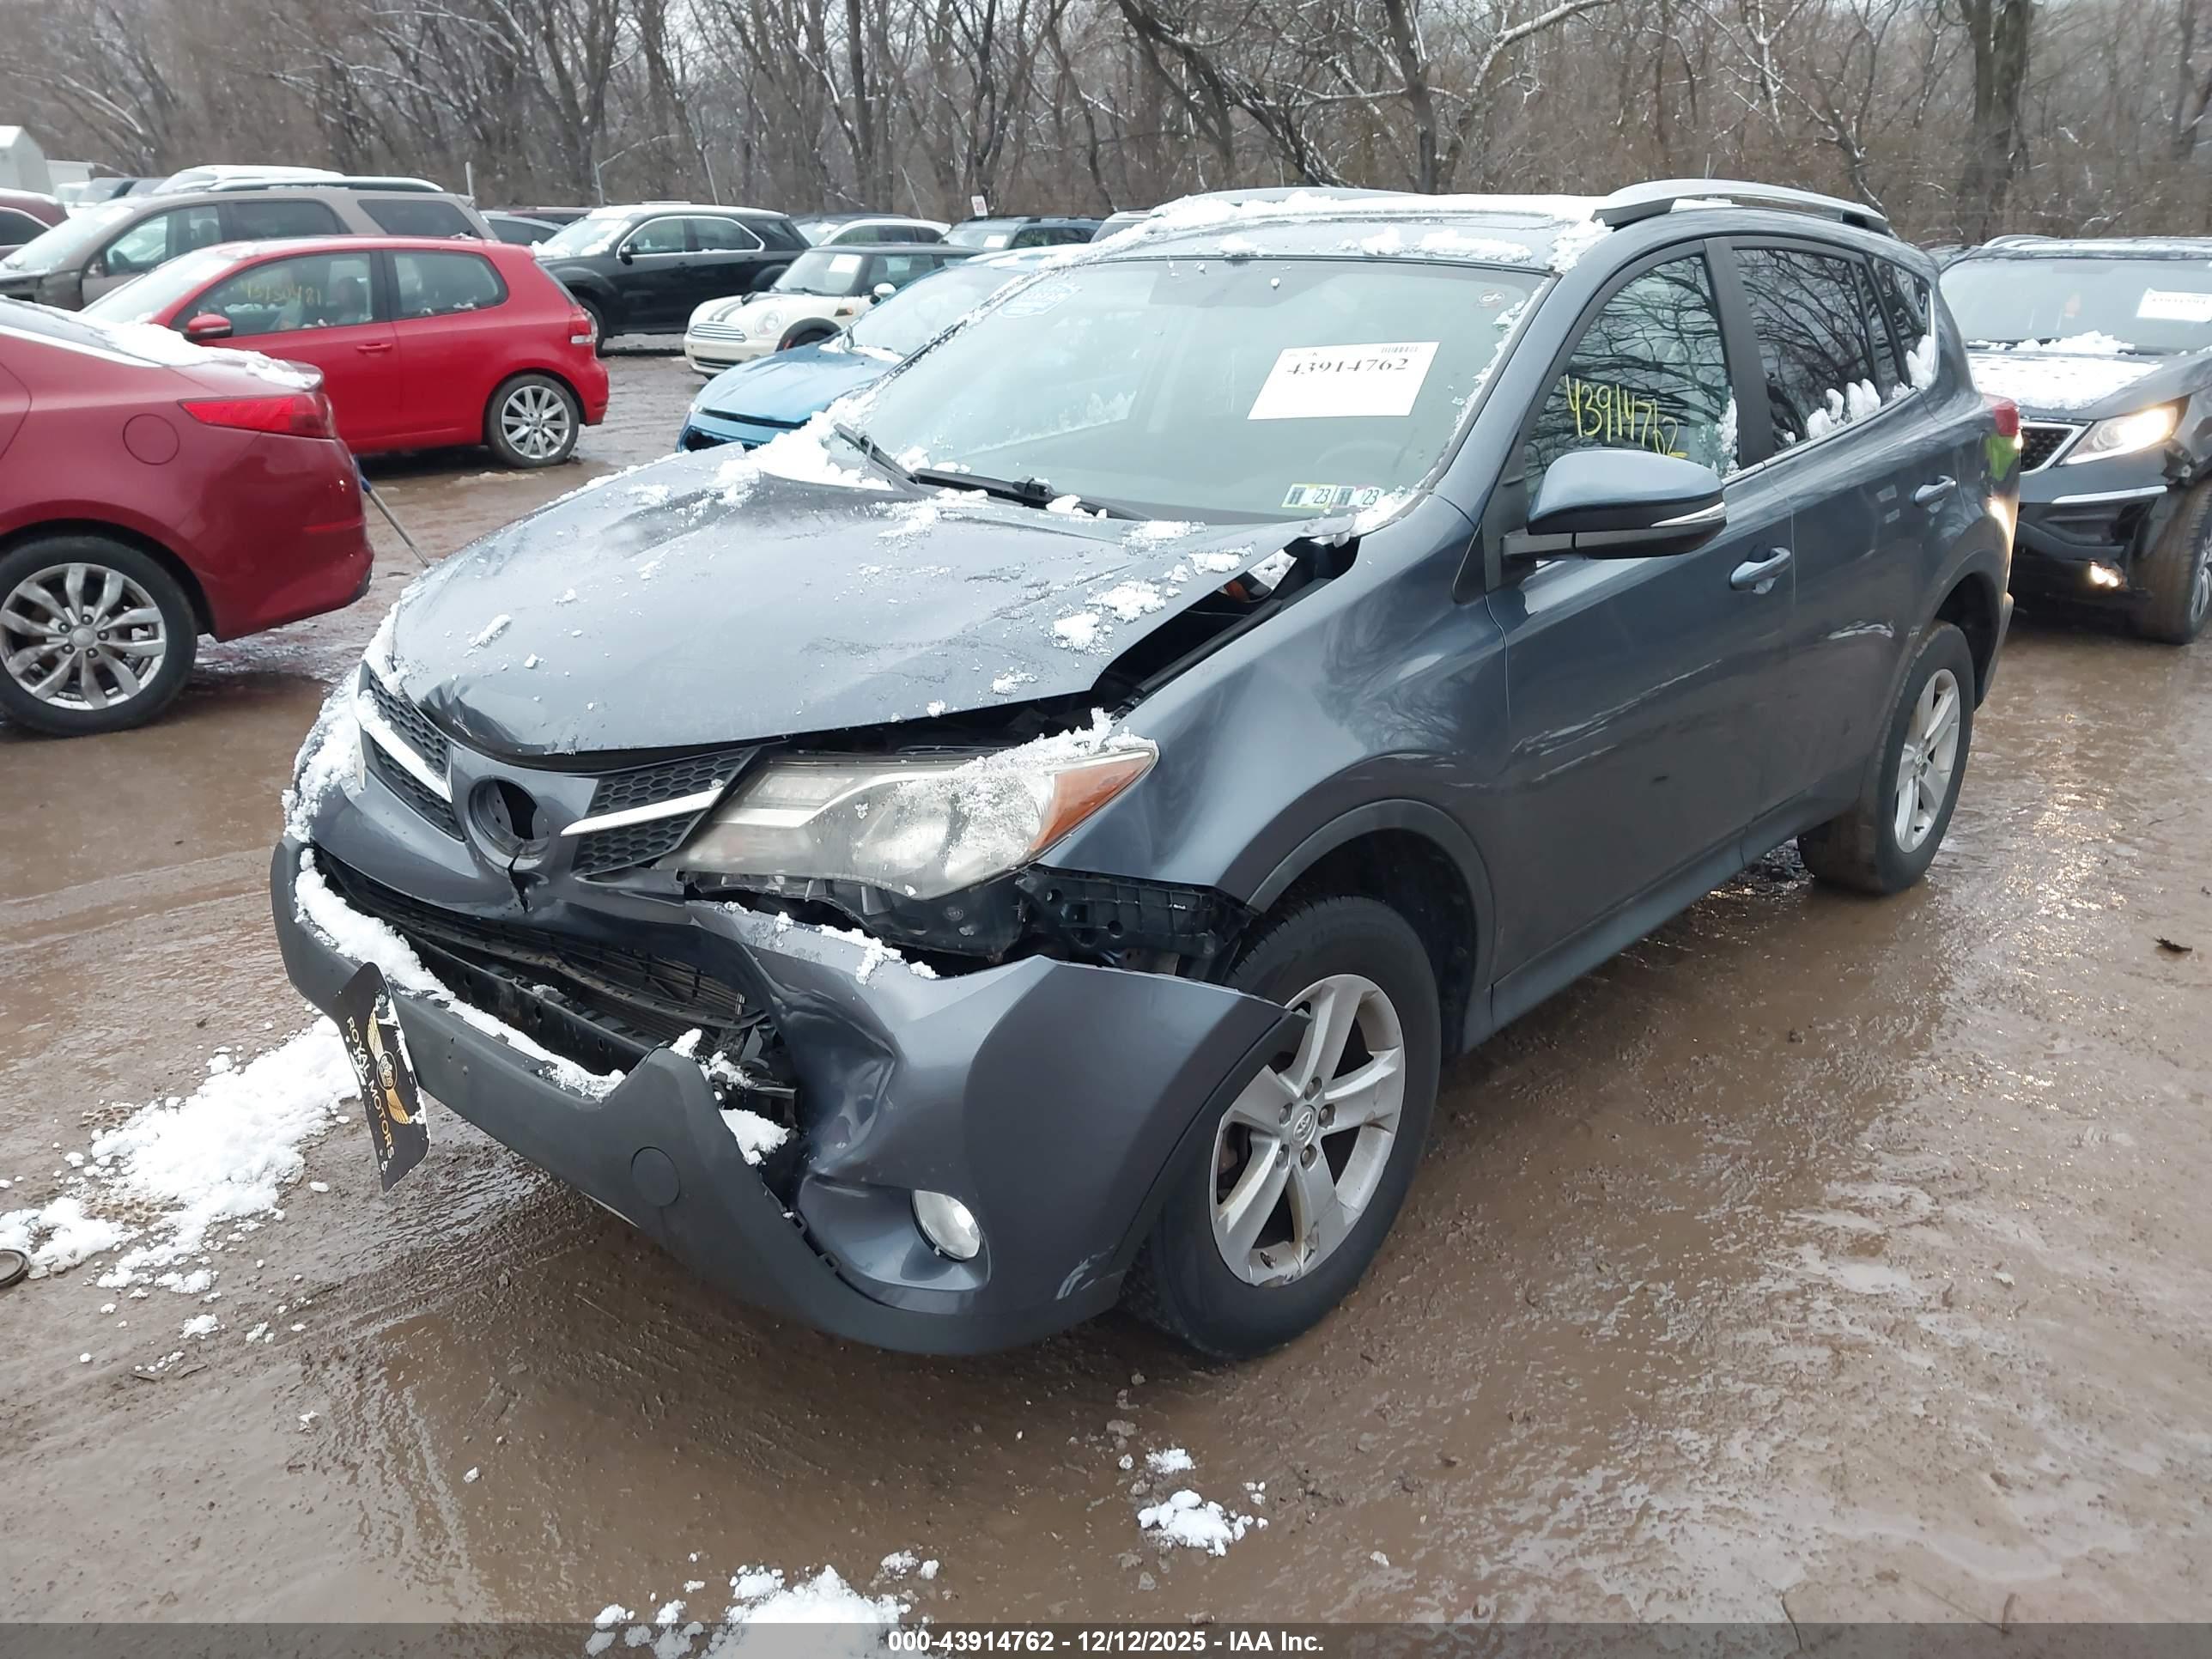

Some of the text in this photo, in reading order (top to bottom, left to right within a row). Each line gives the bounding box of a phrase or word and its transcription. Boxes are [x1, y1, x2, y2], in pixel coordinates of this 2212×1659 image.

[1286, 357, 1409, 375] 43914762
[1565, 374, 1689, 458] 43914762
[1313, 488, 1331, 505] 23
[1362, 489, 1380, 506] 23
[346, 1016, 371, 1077] ROYAL
[368, 1079, 396, 1160] MOTORS
